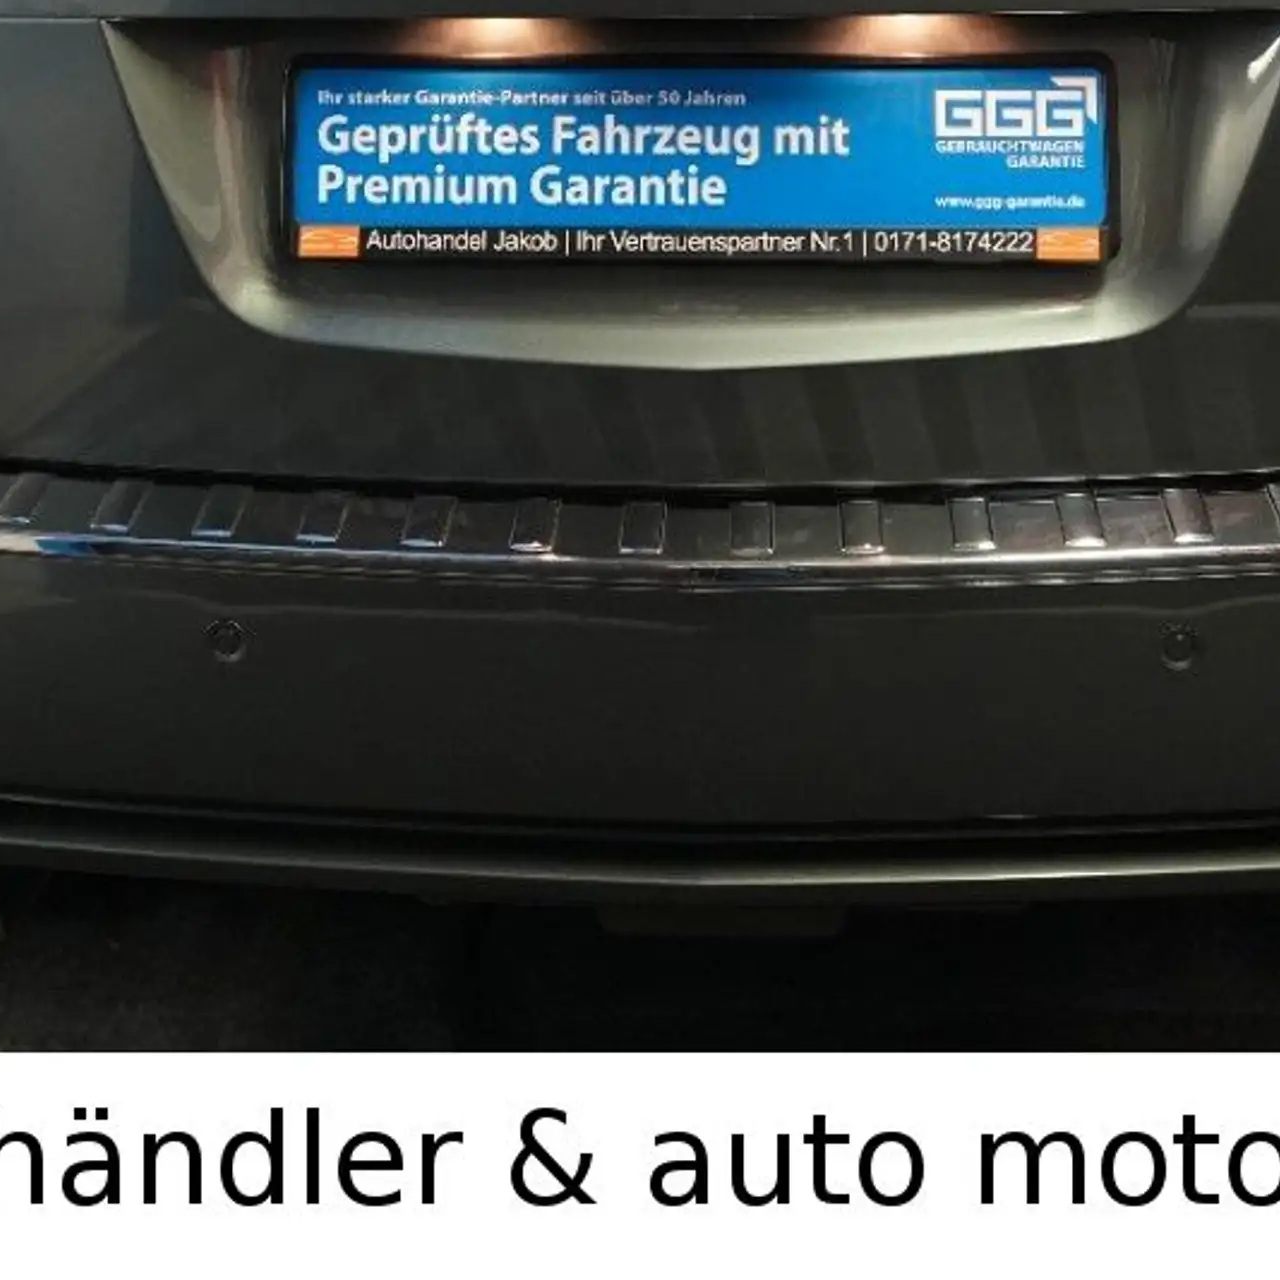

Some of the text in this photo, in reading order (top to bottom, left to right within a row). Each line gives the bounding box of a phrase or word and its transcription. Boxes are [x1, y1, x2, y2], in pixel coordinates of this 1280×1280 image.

[317, 89, 747, 107] Ihr starker Garantie-Partner seit über 50 Jahren
[933, 88, 1086, 138] GGG
[318, 113, 850, 166] Geprüftes Fahrzeug mit
[934, 139, 1086, 155] GEBRAUCHTWAGEN
[1005, 154, 1087, 169] GARANTIE
[318, 163, 727, 206] Premium Garantie
[366, 228, 487, 252] Autohandel
[494, 229, 558, 252] Jakob
[577, 230, 604, 252] Ihr
[612, 230, 805, 255] Vertrauenspartner
[874, 232, 1034, 254] 0171-8174222
